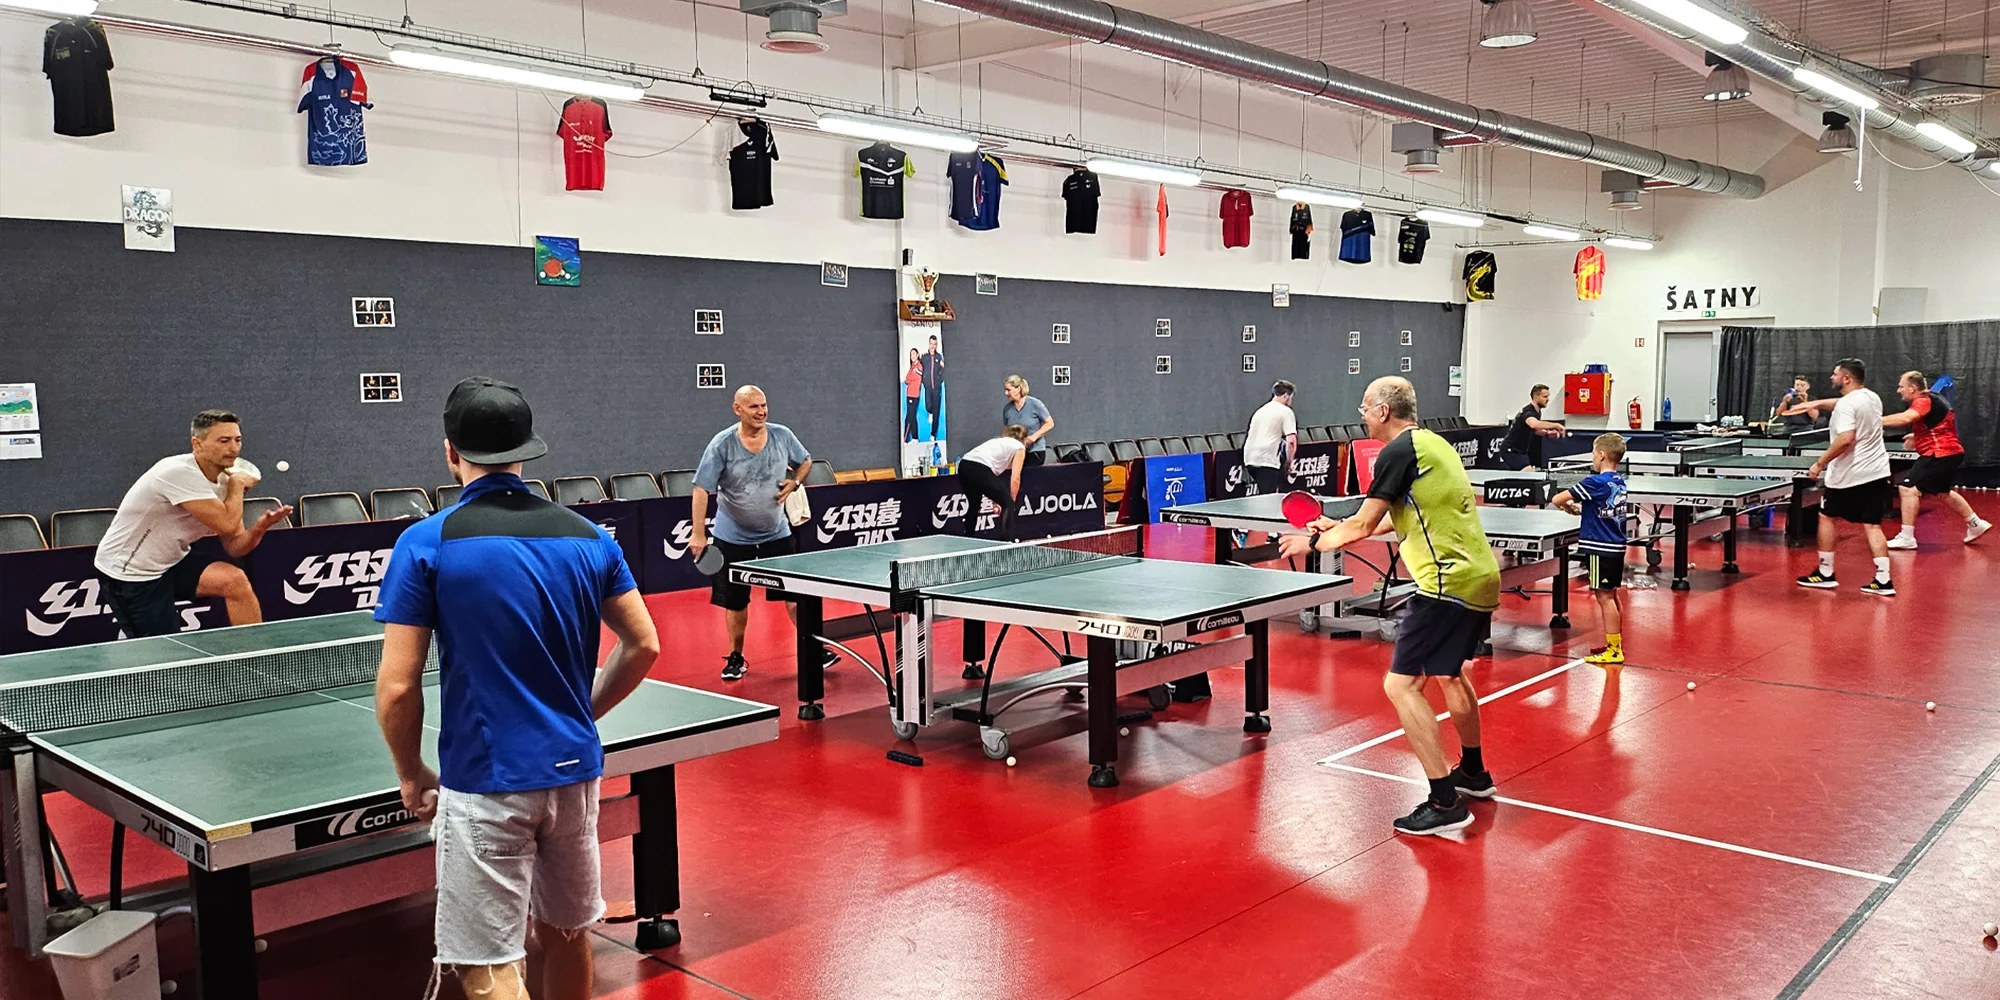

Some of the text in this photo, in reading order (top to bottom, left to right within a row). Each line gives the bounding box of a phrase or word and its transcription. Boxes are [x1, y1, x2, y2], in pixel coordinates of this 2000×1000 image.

[124, 206, 173, 223] DRAGON
[1666, 285, 1757, 311] ŠATNY
[1305, 475, 1328, 488] DHS
[1488, 487, 1531, 499] VICTAS
[1675, 496, 1709, 505] 740
[1034, 491, 1098, 515] JOOLA
[817, 497, 902, 544] 红双喜
[975, 513, 1000, 532] HS
[1077, 619, 1121, 636] 740
[1207, 614, 1240, 629] cornilleau
[140, 813, 176, 849] 740
